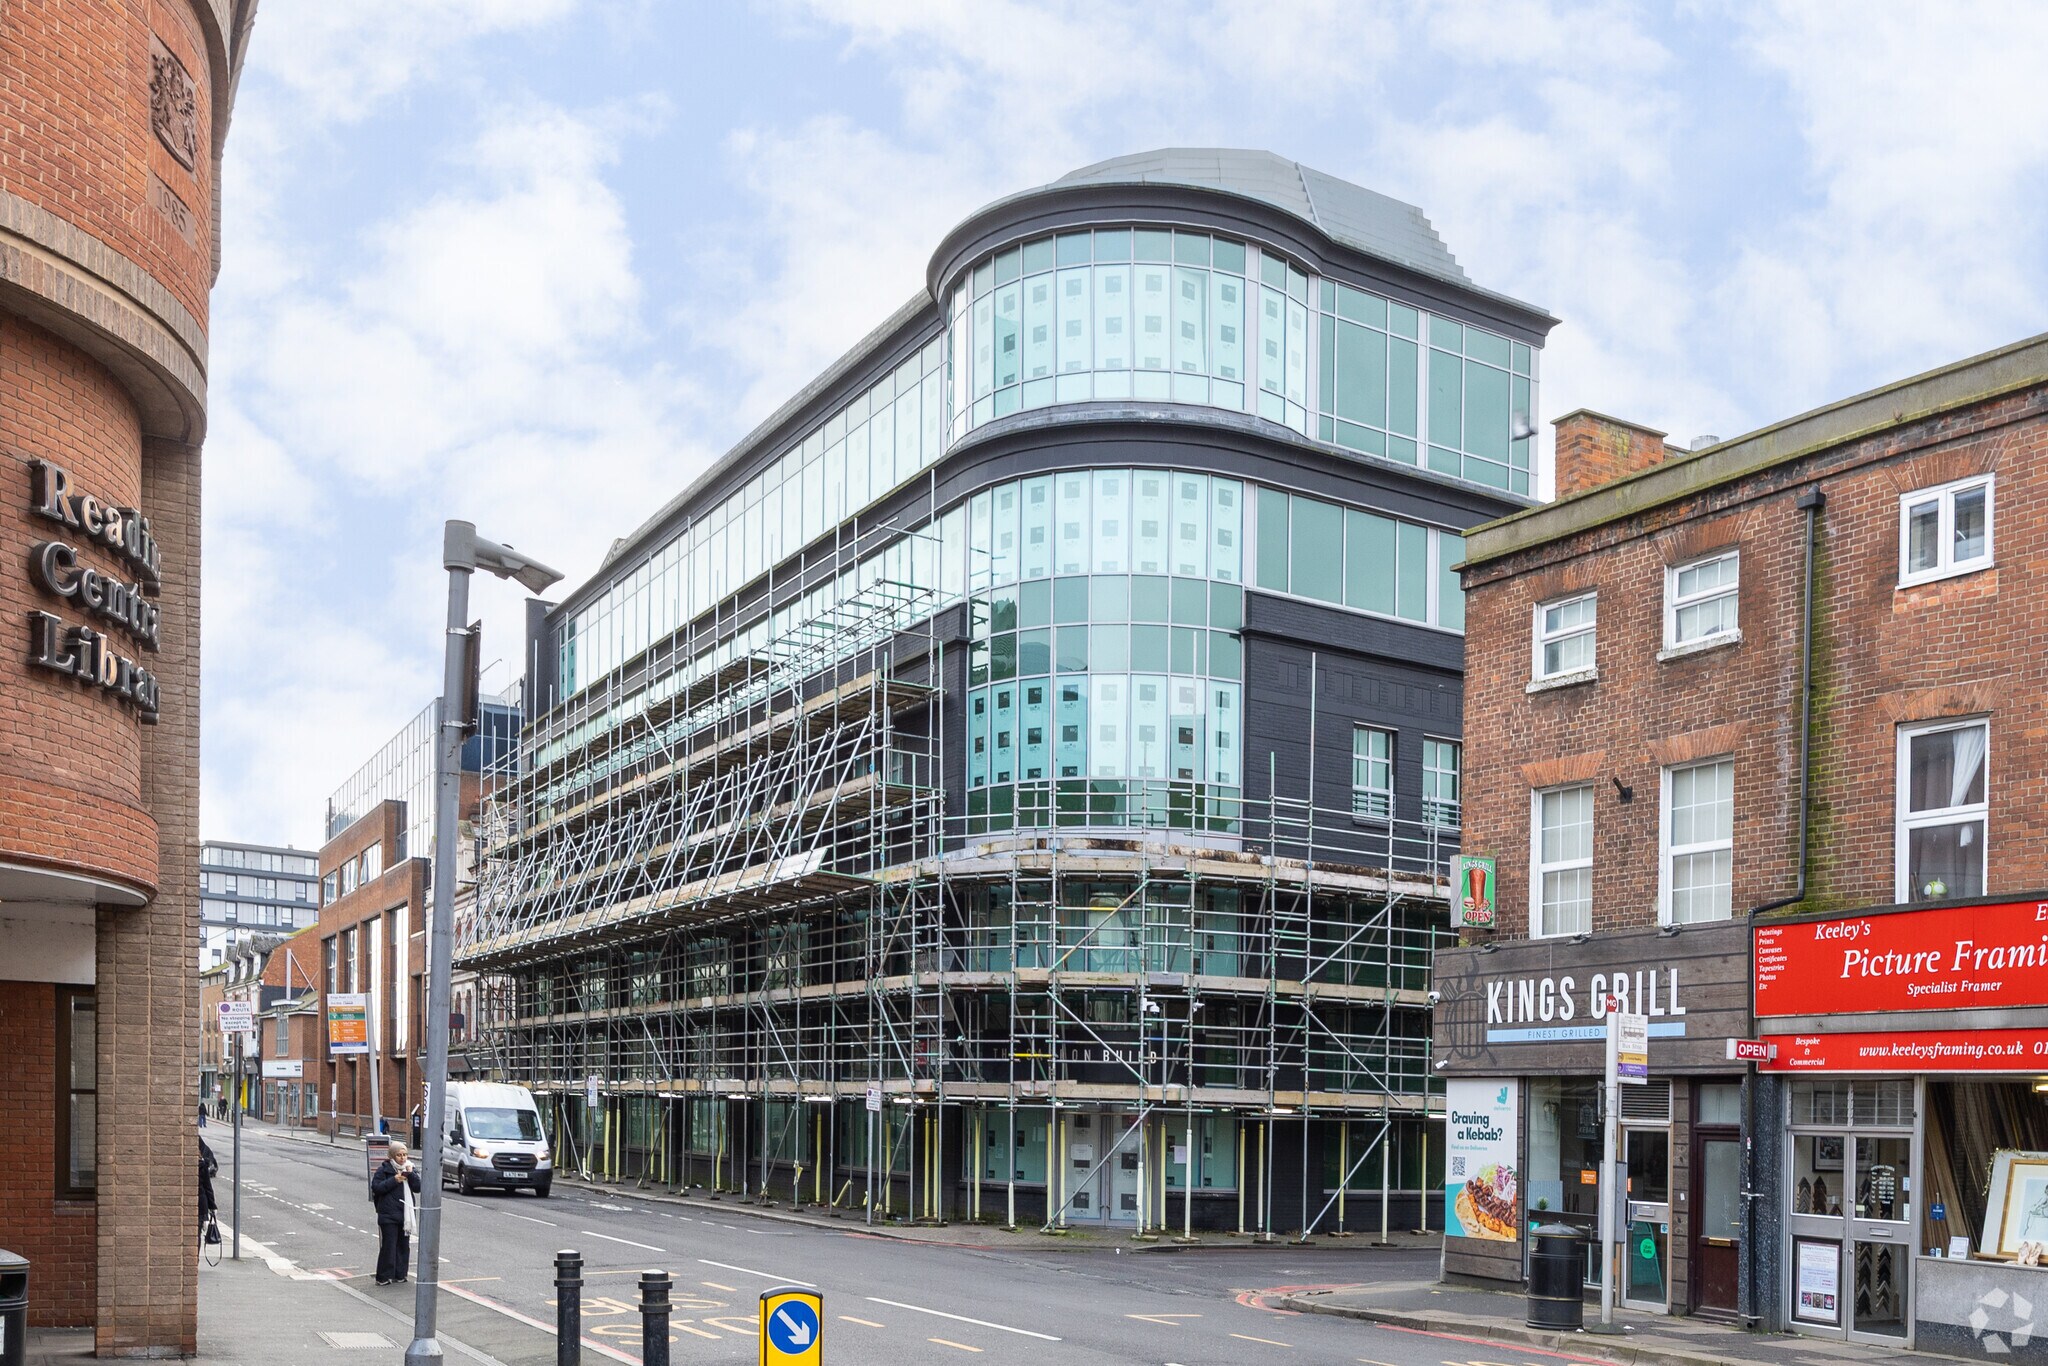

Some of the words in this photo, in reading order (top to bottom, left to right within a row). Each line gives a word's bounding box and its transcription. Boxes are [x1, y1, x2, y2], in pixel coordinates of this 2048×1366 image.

[1463, 860, 1478, 870] KINGS
[1465, 910, 1491, 922] OPEN
[2035, 903, 2048, 921] E
[1758, 929, 1783, 937] Paintings
[1815, 920, 1871, 941] Keeley’s
[1758, 938, 1775, 946] Prints
[1758, 956, 1788, 964] Certificates
[1840, 948, 1941, 979] Picture
[1759, 964, 1785, 973] Tapestries
[1759, 973, 1777, 981] Photos
[1759, 982, 1768, 990] Etc
[1907, 980, 1957, 997] Specialist
[1960, 979, 2003, 992] Framer
[1487, 976, 1576, 1024] KINGS
[1590, 968, 1686, 1020] GRILL
[1606, 999, 1616, 1007] MG
[1527, 1029, 1557, 1039] FINEST
[1561, 1028, 1601, 1039] GRILLED
[1795, 1037, 1821, 1046] Bespoke
[1738, 1043, 1767, 1057] OPEN
[1804, 1047, 1811, 1056] &
[1859, 1041, 2024, 1060] www.keeleysframing.co.uk
[1789, 1058, 1826, 1067] Commercial
[1451, 1110, 1490, 1129] Craving
[1457, 1130, 1464, 1140] a
[1466, 1126, 1504, 1142] Kebab?
